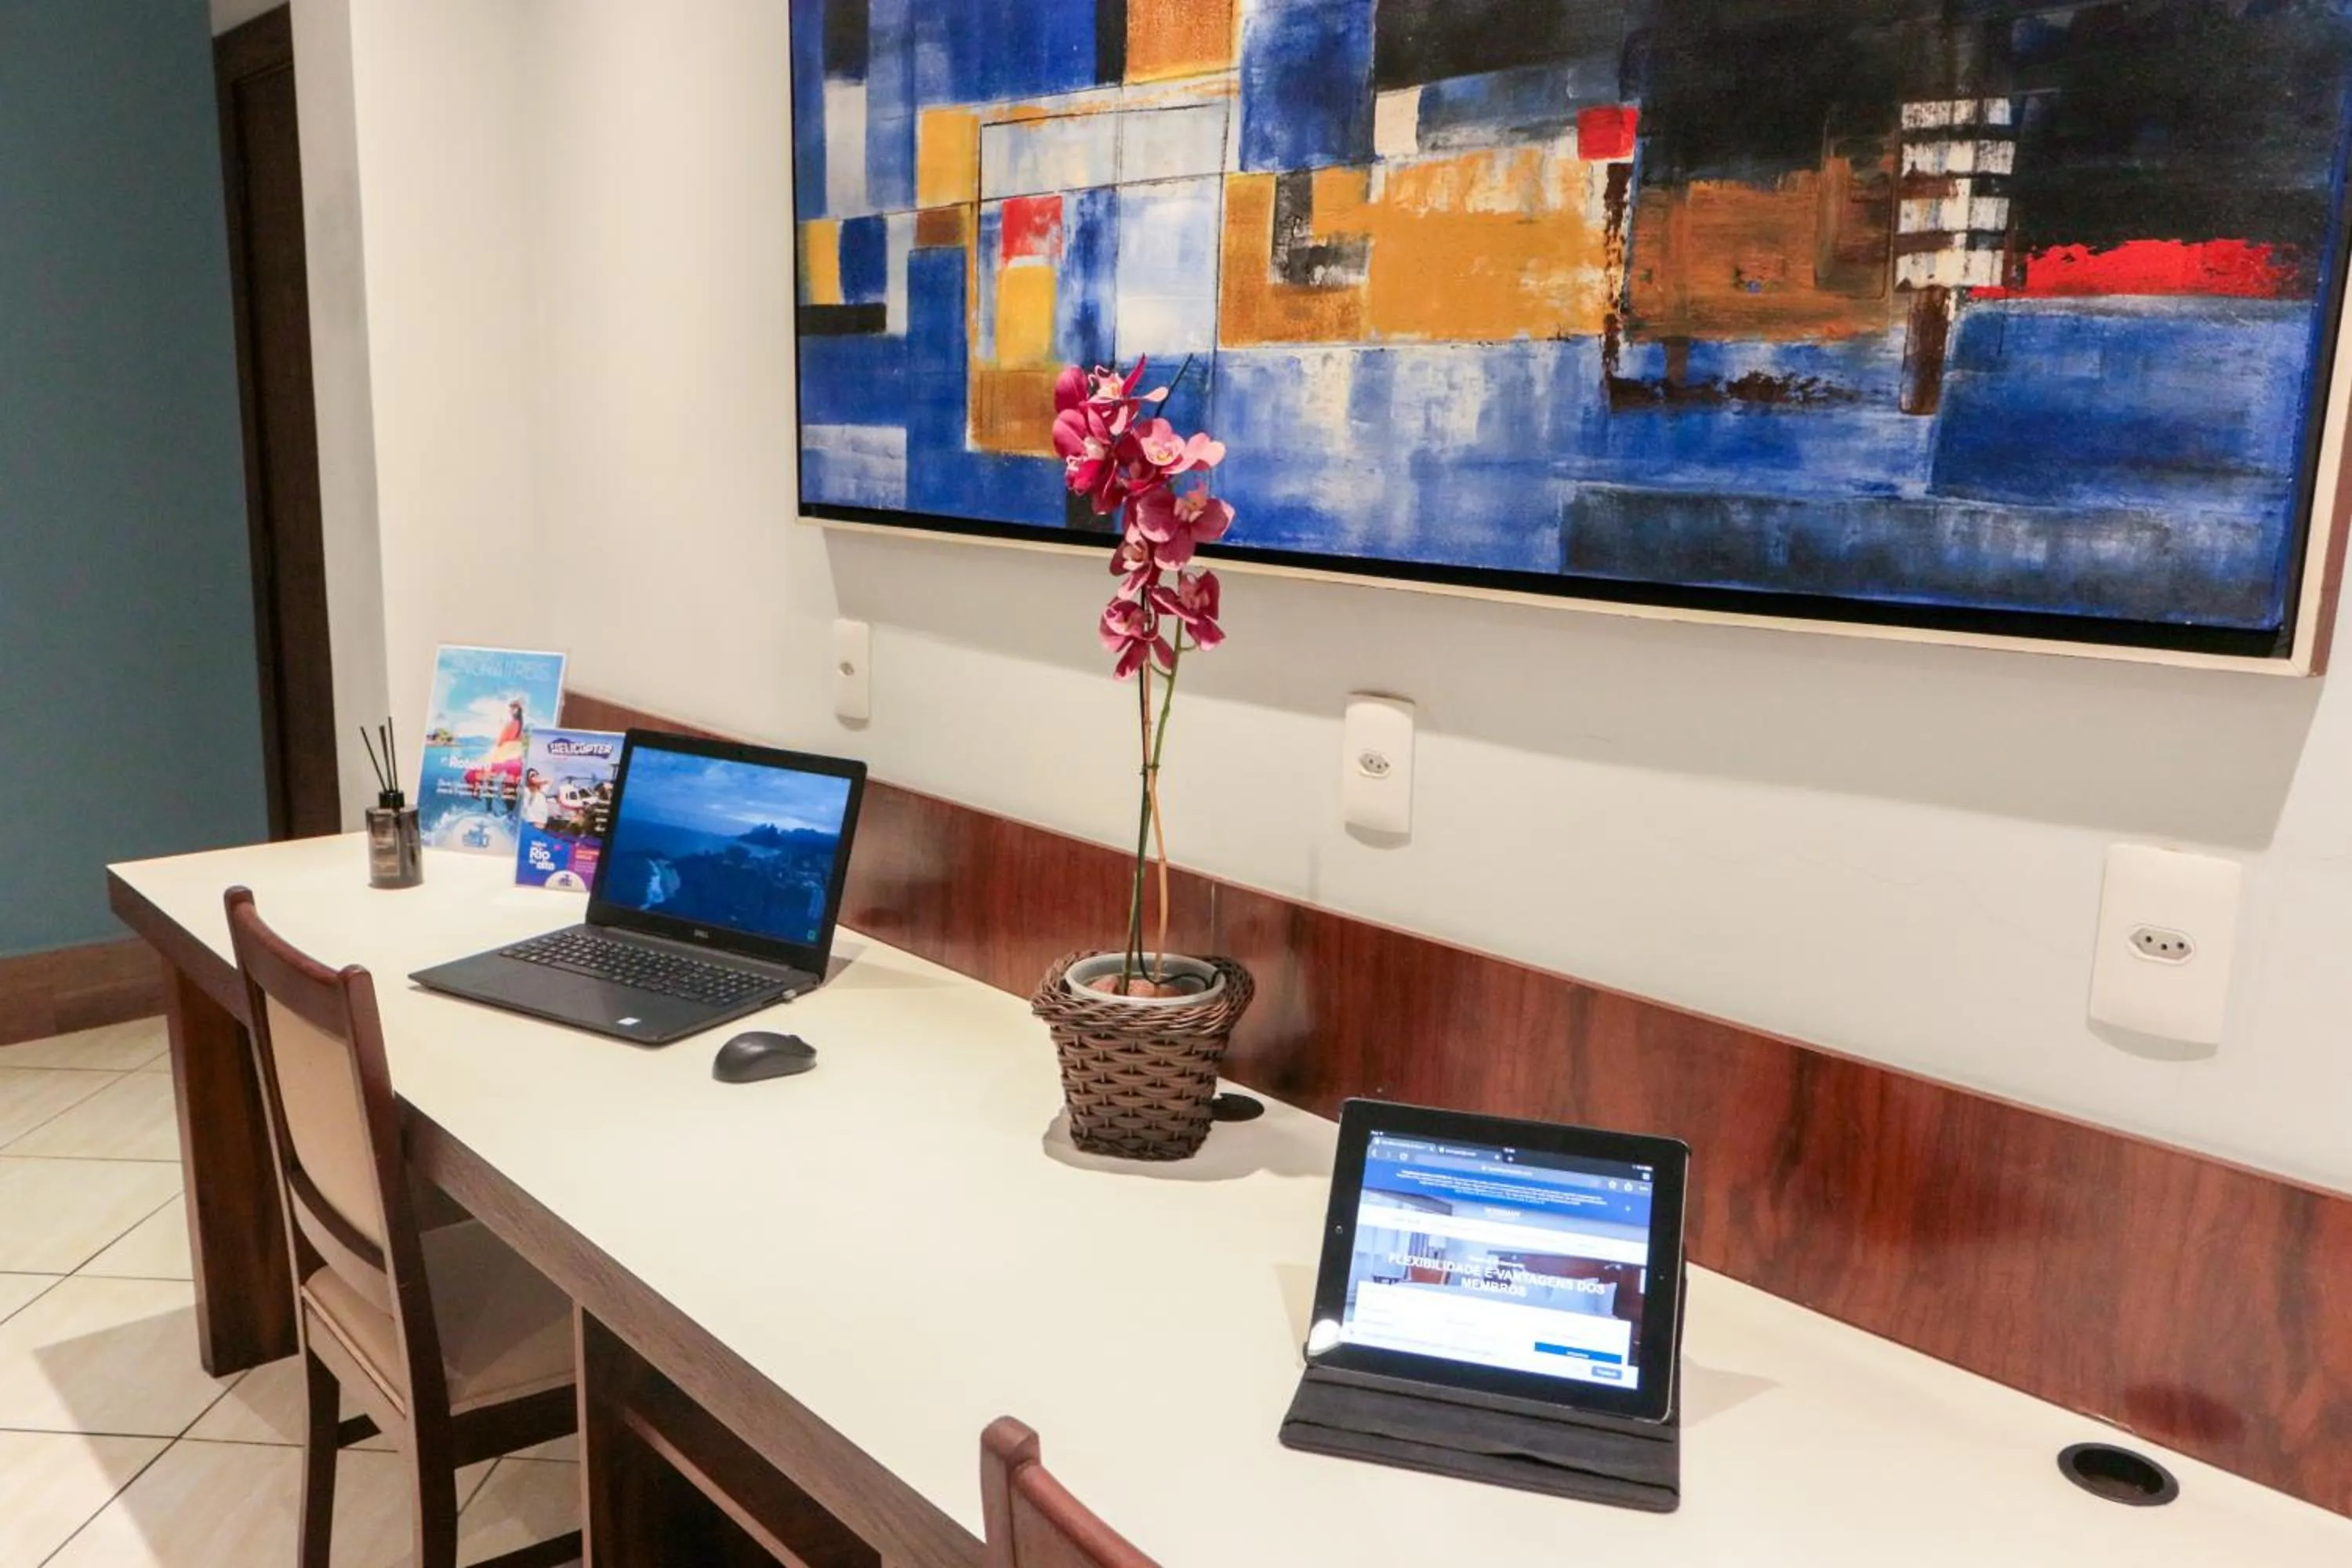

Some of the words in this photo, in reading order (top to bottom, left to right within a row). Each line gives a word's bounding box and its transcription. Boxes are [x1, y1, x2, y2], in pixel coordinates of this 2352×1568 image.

[1388, 1253, 1481, 1276] FLEXIBILIDADE
[1495, 1269, 1573, 1290] VANTAGENS
[1577, 1281, 1606, 1295] DOS
[1461, 1277, 1527, 1298] MEMBROS
